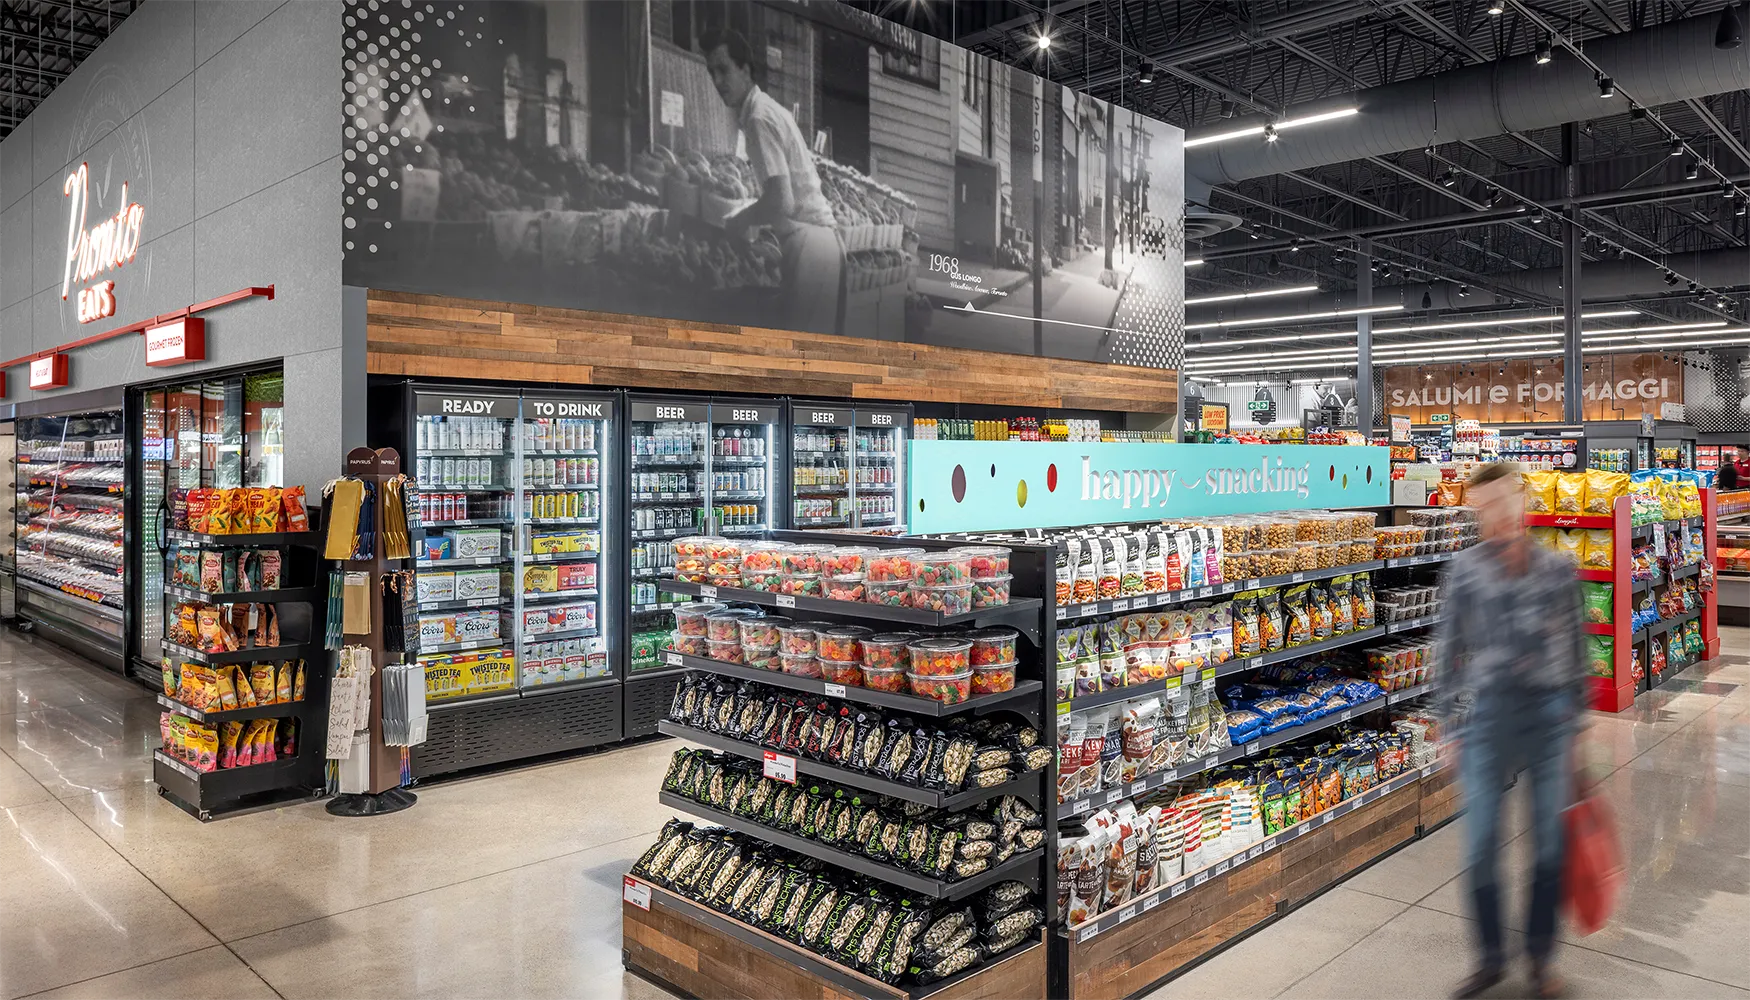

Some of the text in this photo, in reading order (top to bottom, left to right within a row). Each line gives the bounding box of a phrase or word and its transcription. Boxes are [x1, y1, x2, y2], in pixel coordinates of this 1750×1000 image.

[63, 161, 145, 300] Pronto
[929, 254, 959, 275] 1968
[950, 272, 982, 283] GUS LONGO
[77, 279, 116, 324] EATS
[1190, 385, 1195, 395] 6
[1391, 385, 1481, 407] SALUMI
[1489, 384, 1509, 403] e
[442, 399, 603, 417] READY TO DRINK
[656, 406, 685, 419] BEER
[732, 409, 758, 422] BEER
[812, 412, 835, 424] BEER
[871, 414, 892, 425] BEER
[1080, 455, 1311, 509] happy snacking
[527, 616, 547, 626] Coors
[567, 612, 586, 621] Coors
[421, 626, 444, 636] Coors
[464, 621, 490, 631] Coors
[449, 668, 461, 677] TEA
[469, 662, 511, 675] TWISTED TEA
[699, 846, 729, 893] PISTACHIOS
